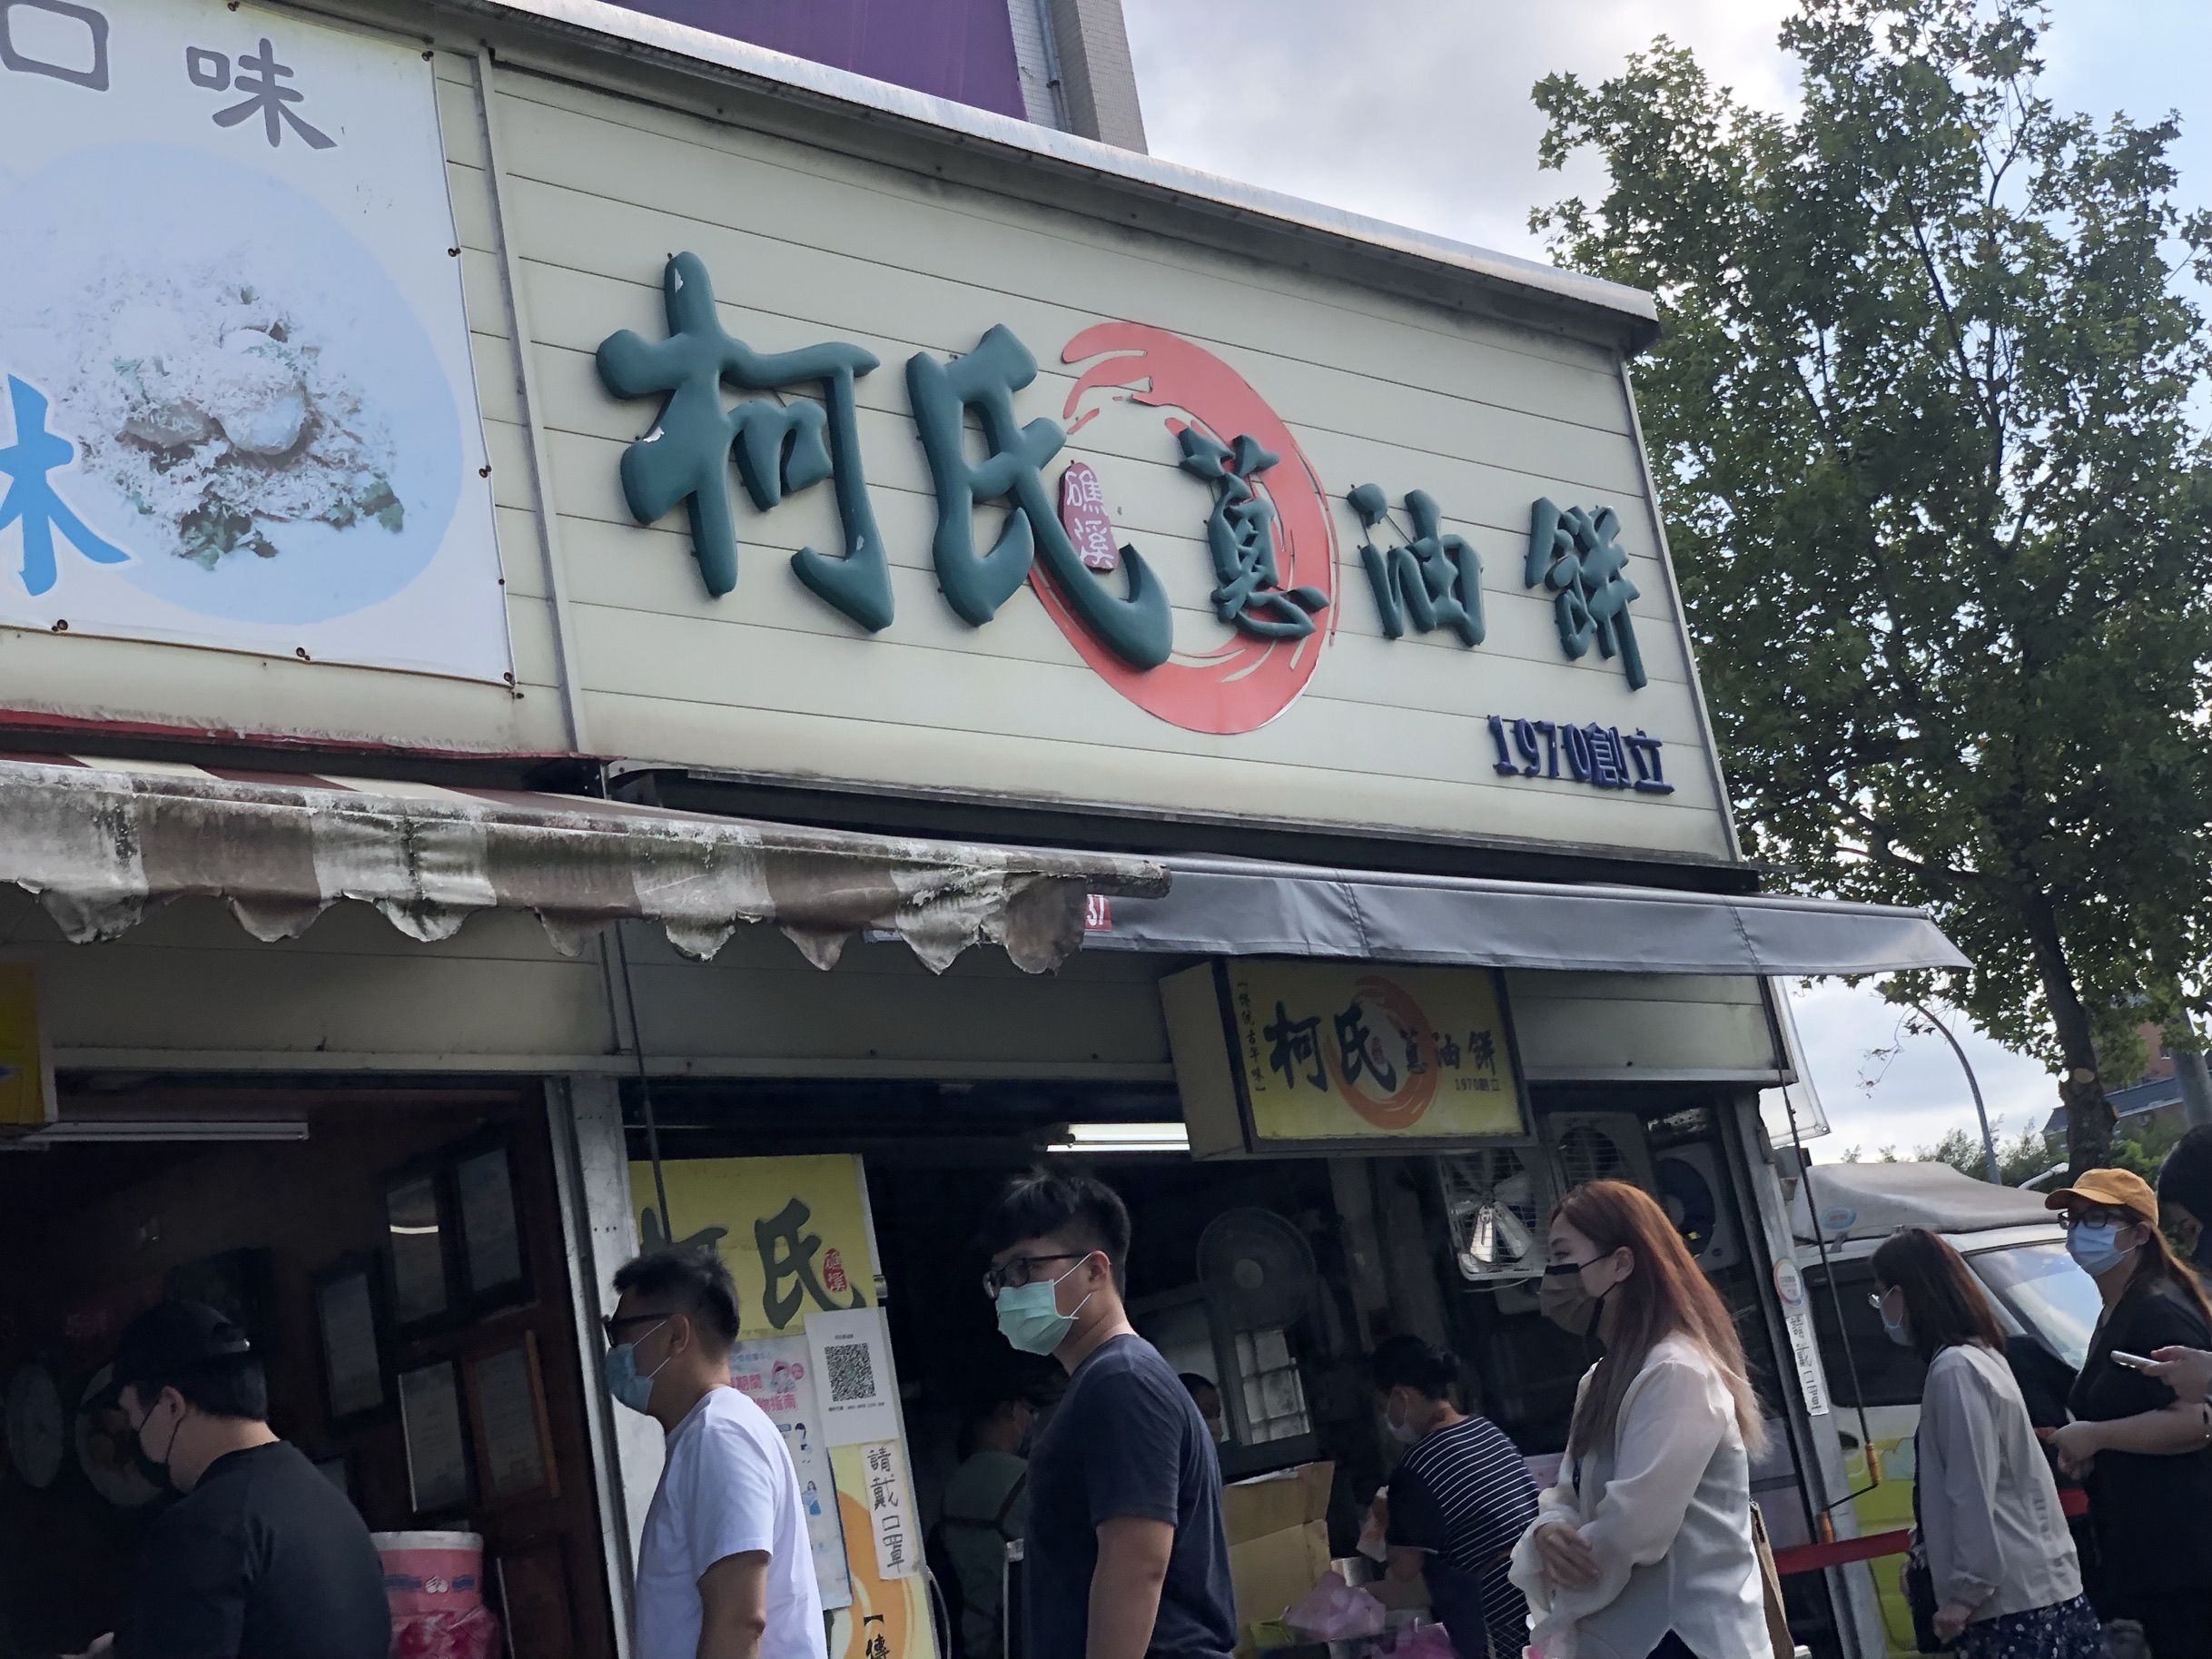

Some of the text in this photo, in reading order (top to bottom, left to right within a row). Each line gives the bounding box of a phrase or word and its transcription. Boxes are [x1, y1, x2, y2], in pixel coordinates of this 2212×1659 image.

[0, 0, 338, 150] 口味
[1487, 715, 1675, 795] 1970創立
[866, 1446, 905, 1575] 請戴口罩
